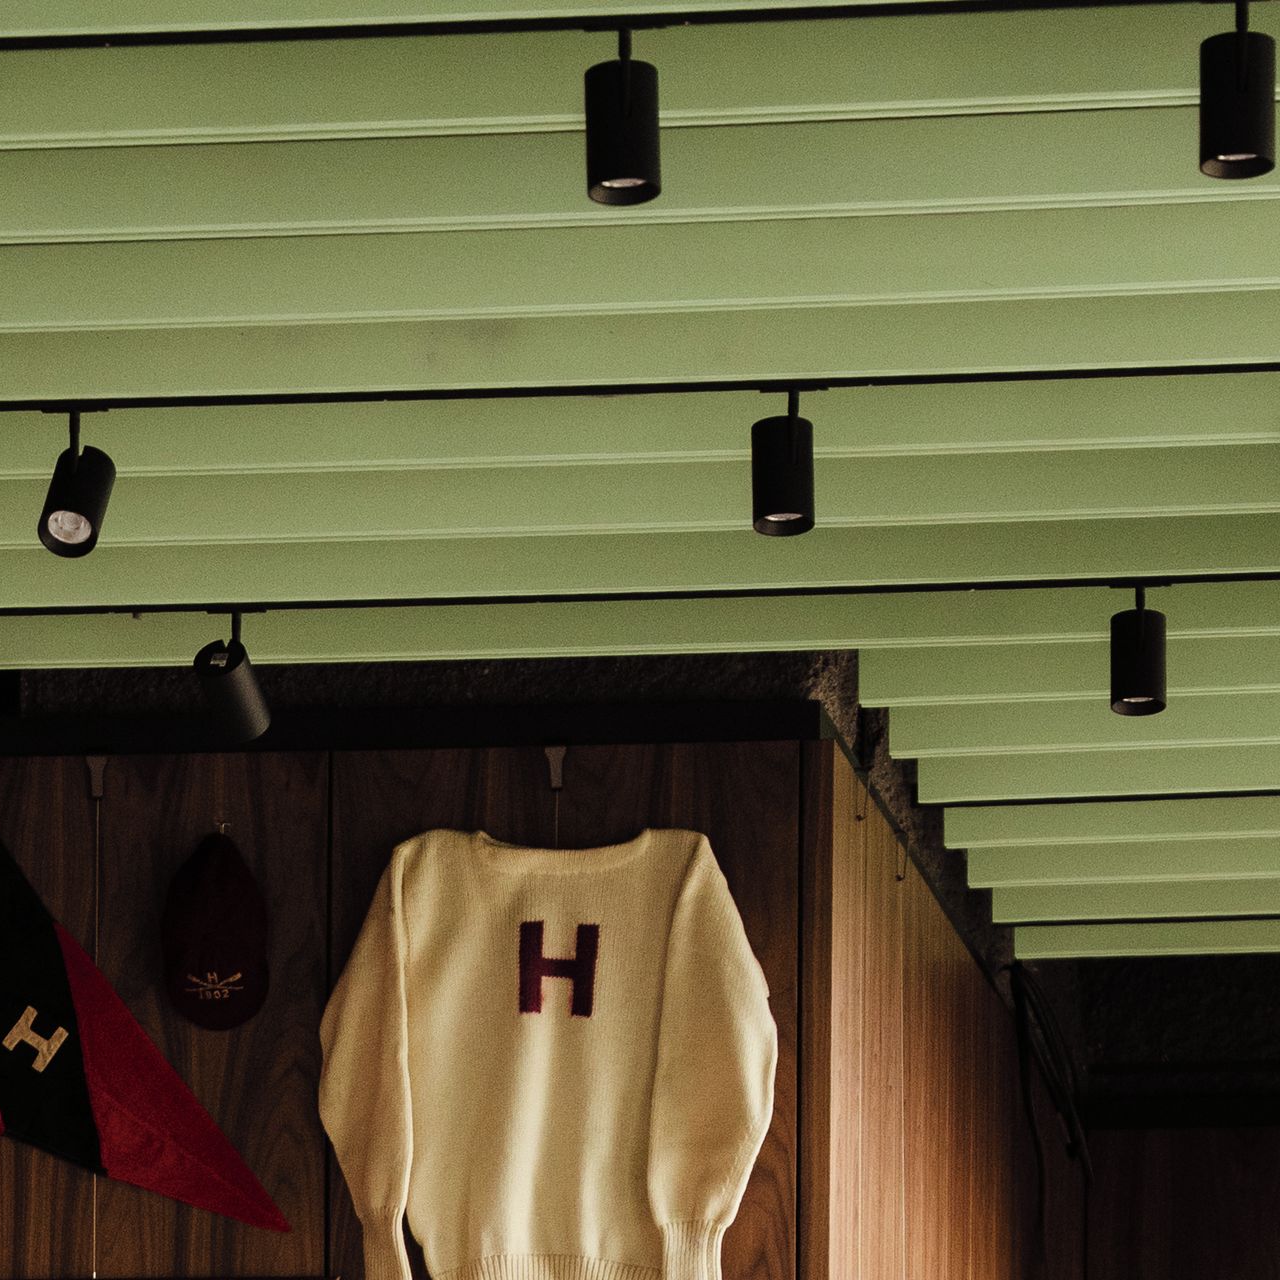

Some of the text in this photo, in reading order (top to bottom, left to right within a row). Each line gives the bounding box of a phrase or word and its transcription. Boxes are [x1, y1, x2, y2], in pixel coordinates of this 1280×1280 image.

[207, 971, 219, 984] H
[518, 920, 600, 1017] H
[2, 1005, 69, 1073] H
